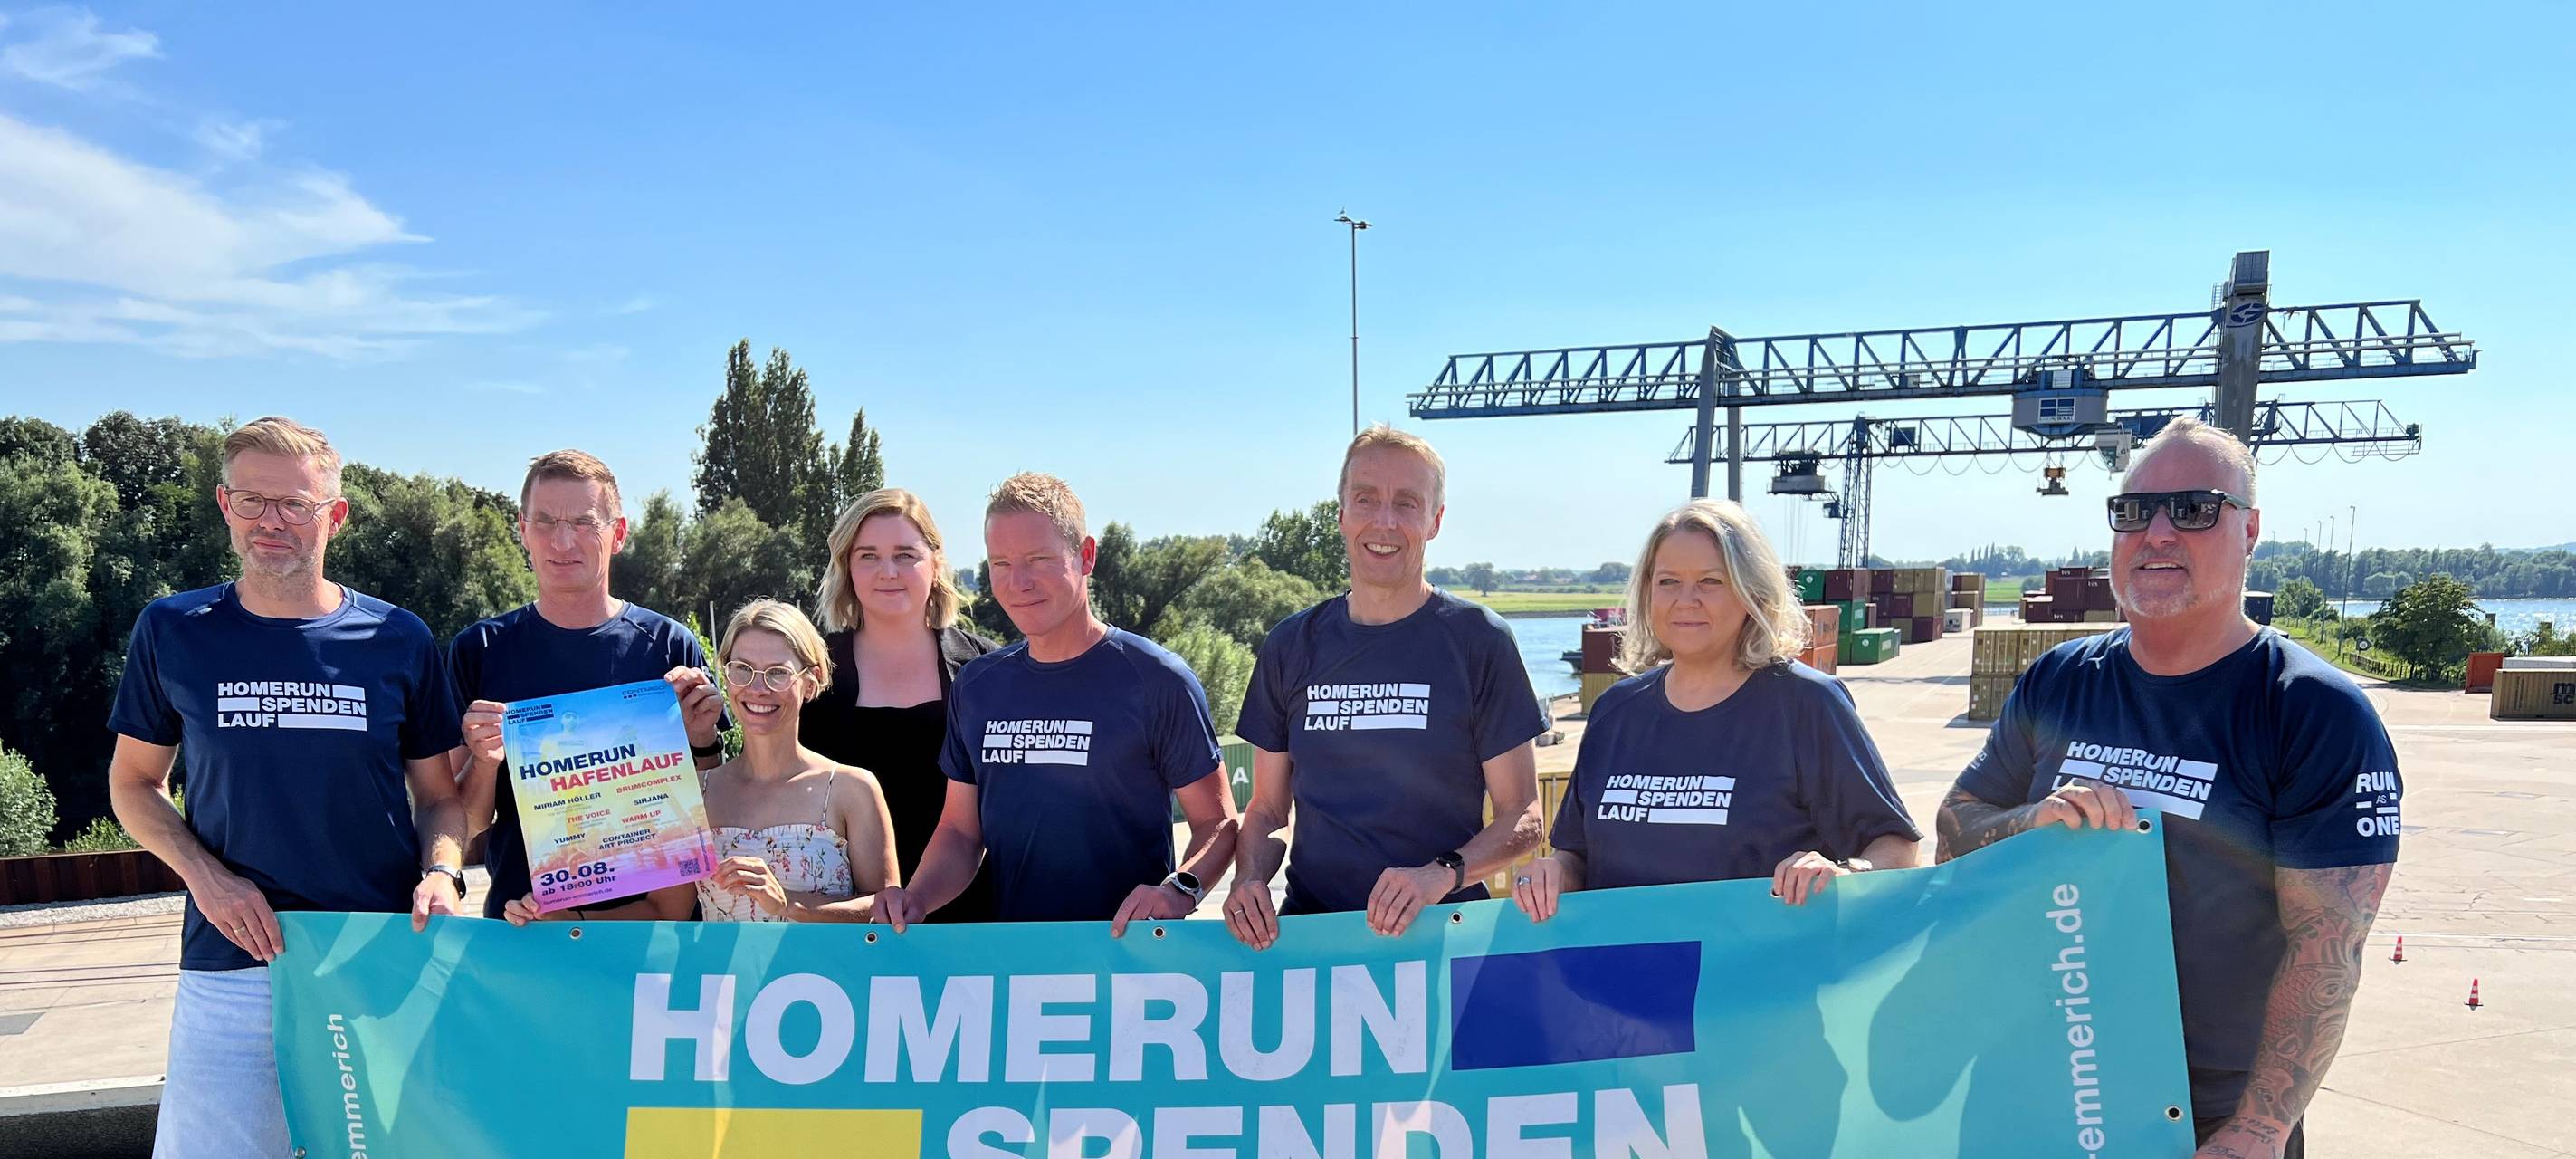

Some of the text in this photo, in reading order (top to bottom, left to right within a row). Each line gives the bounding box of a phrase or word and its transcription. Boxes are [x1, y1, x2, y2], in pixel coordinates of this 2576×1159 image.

[217, 681, 331, 697] HOMERUN
[1307, 683, 1399, 700] HOMERUN
[262, 696, 367, 716] SPENDEN
[1340, 699, 1429, 715] SPENDEN
[217, 713, 275, 728] LAUF
[985, 720, 1067, 734] HOMERUN
[1303, 715, 1350, 731] LAUF
[1012, 734, 1091, 751] SPENDEN
[519, 743, 636, 780] HOMERUN
[981, 749, 1025, 764] LAUF
[2066, 741, 2179, 774] HOMERUN
[549, 752, 684, 792] HAFENLAUF
[615, 774, 682, 794] DRUMCOMPLEX
[1606, 774, 1704, 790] HOMERUN
[2104, 766, 2213, 801] SPENDEN
[2355, 771, 2397, 794] RUN
[533, 800, 566, 811] MIRIAM
[568, 792, 602, 804] HÖLLER
[634, 793, 670, 806] SIRJANA
[1637, 790, 1732, 809] SPENDEN
[2375, 794, 2387, 805] AS
[566, 815, 584, 824] THE
[585, 809, 611, 819] VOICE
[621, 814, 648, 824] WARM
[649, 809, 662, 819] UP
[1597, 804, 1649, 823] LAUF
[602, 828, 651, 843] CONTAINER
[2356, 815, 2400, 838] ONE
[553, 832, 586, 845] YUMMY
[598, 842, 615, 851] ART
[616, 832, 657, 847] PROJECT
[540, 861, 615, 886] 30.08.
[541, 875, 616, 896] ab 18:00 Uhr
[629, 959, 1428, 1086] HOMERUN
